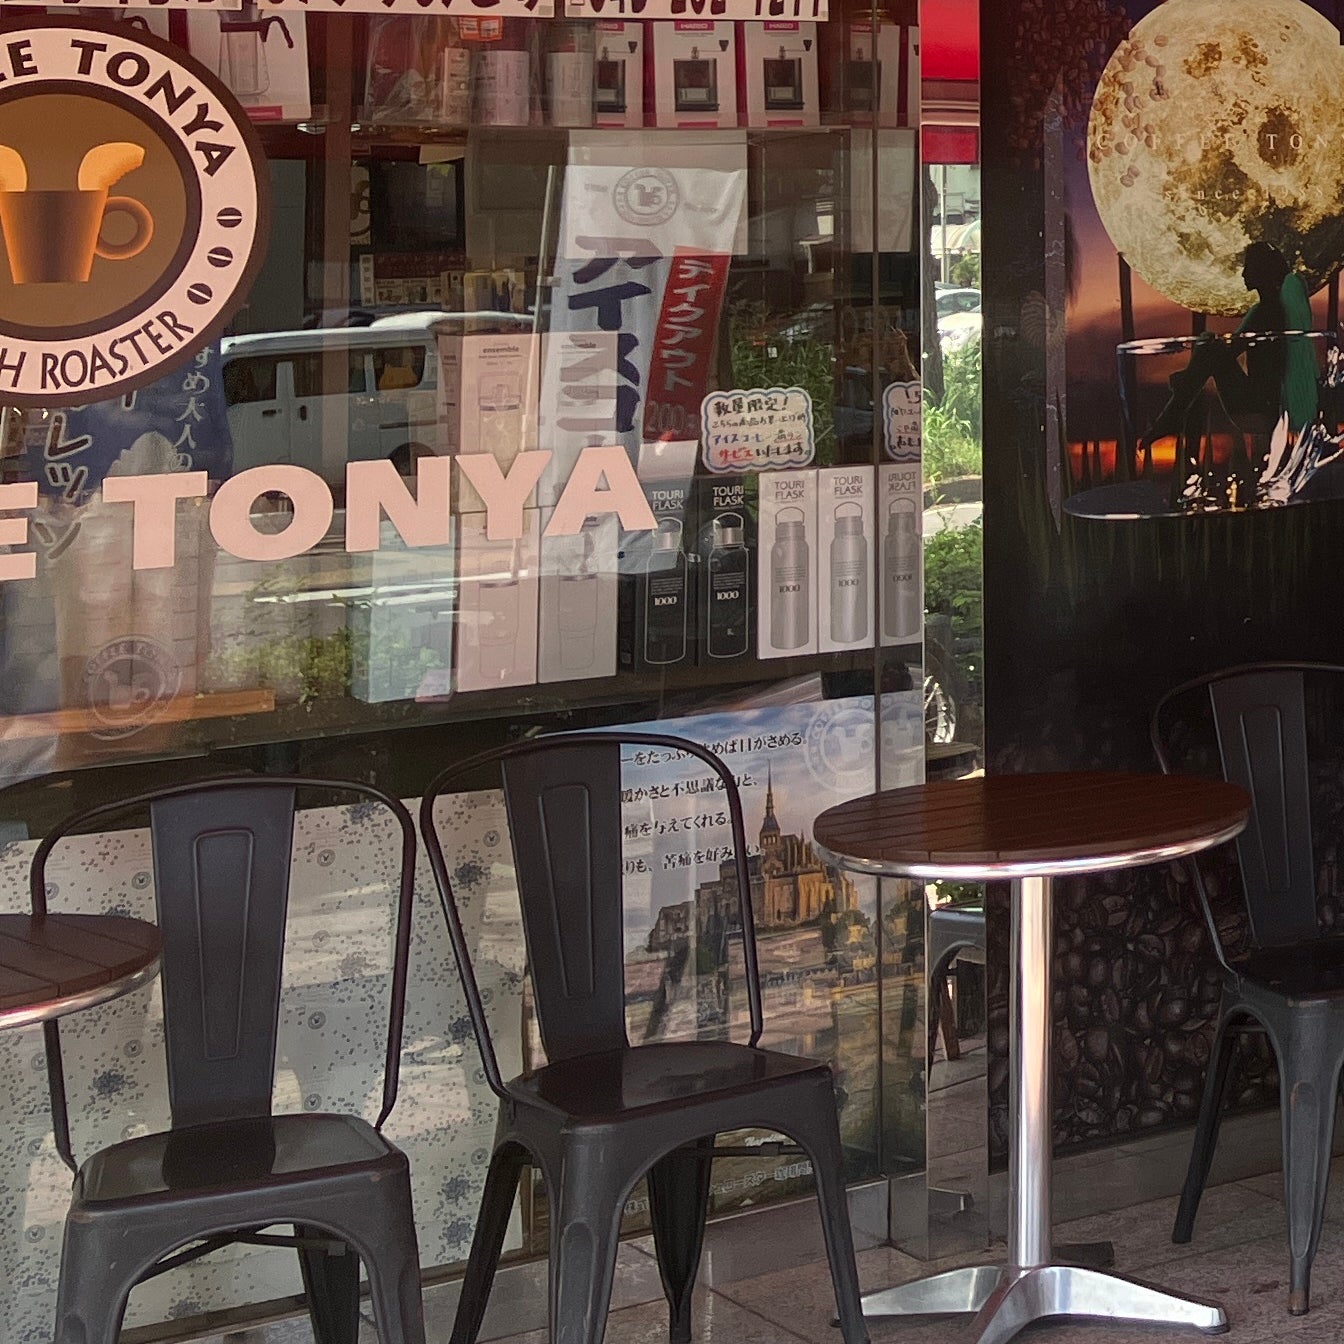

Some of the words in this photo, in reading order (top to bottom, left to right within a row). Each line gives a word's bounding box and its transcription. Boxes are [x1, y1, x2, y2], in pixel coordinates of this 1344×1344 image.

[70, 39, 236, 177] TONYA
[1097, 133, 1240, 151] COFFEE
[661, 259, 714, 392] テイクアウト
[41, 310, 195, 390] ROASTER
[775, 490, 806, 500] FLASK
[834, 486, 864, 496] FLASK
[652, 500, 685, 510] FLASK
[713, 496, 745, 506] FLASK
[103, 446, 659, 571] TONYA
[716, 590, 740, 600] 1000
